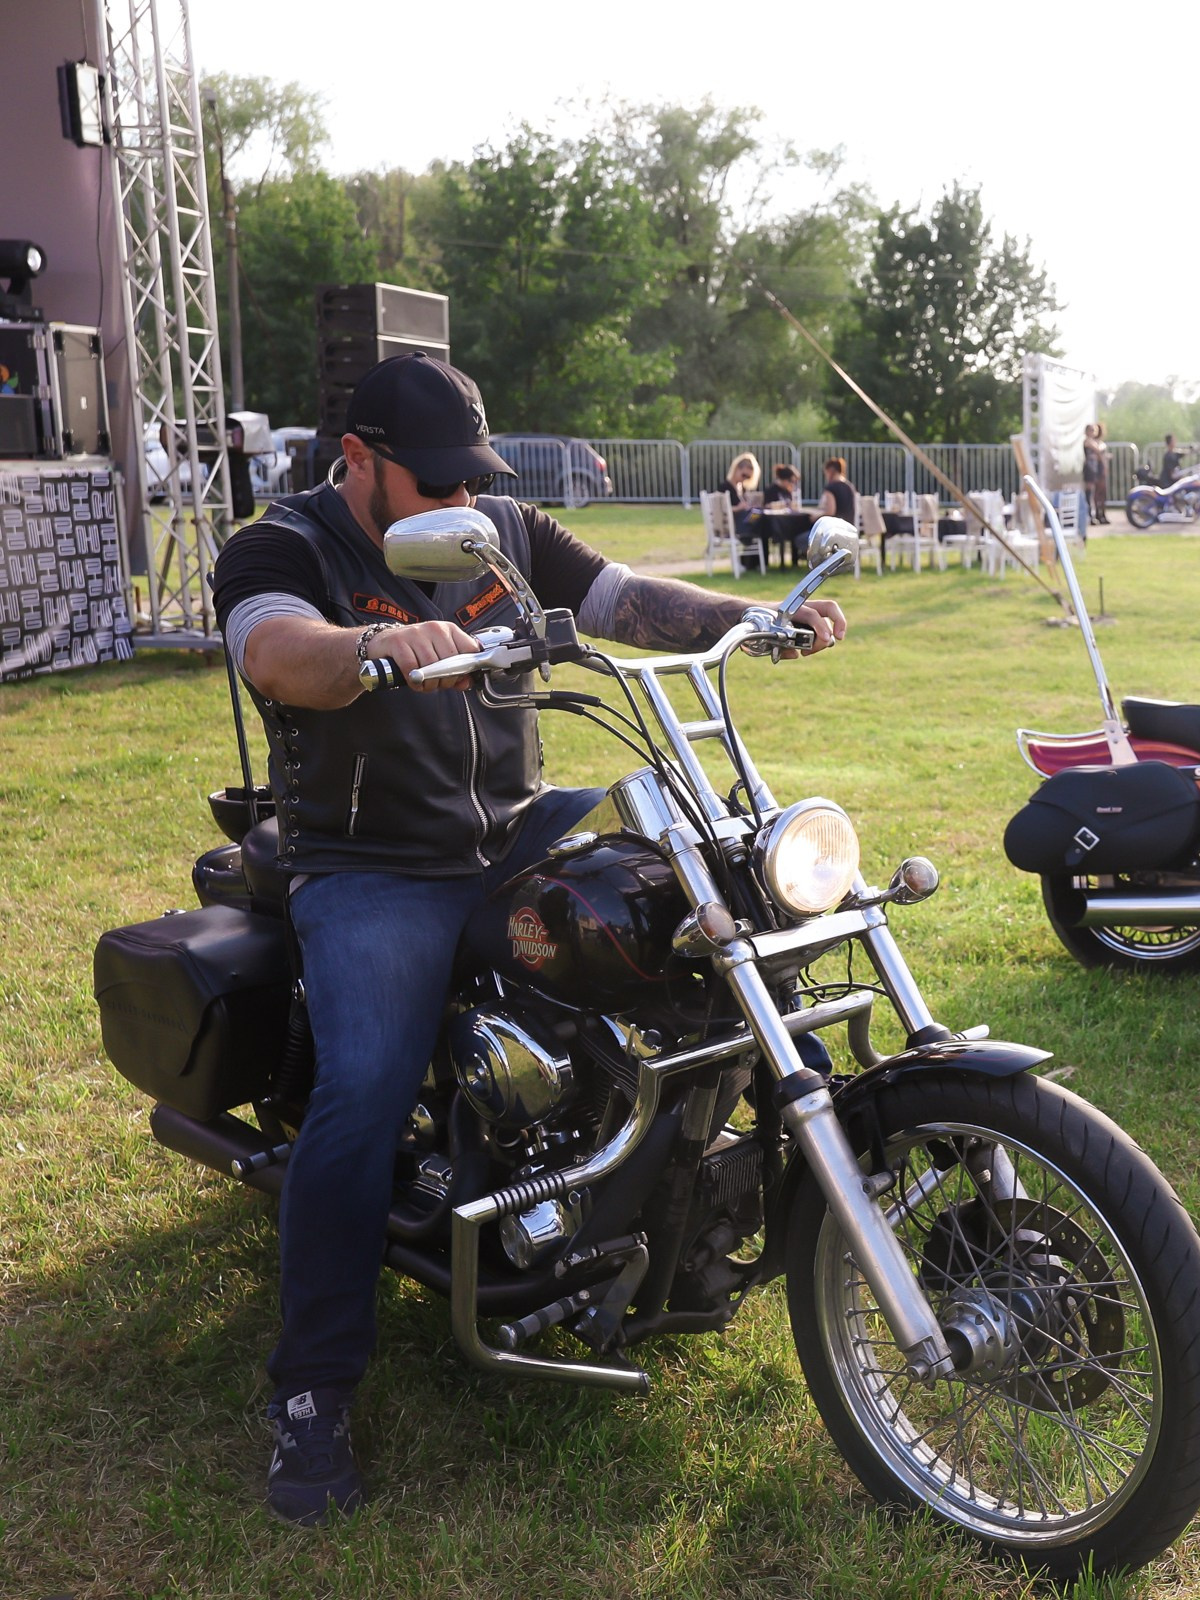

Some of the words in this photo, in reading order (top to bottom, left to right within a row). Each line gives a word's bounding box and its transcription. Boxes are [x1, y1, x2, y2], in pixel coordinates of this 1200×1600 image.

[355, 423, 386, 435] VERSTA
[507, 916, 547, 939] HARLEY-
[512, 940, 557, 958] DAVIDSON
